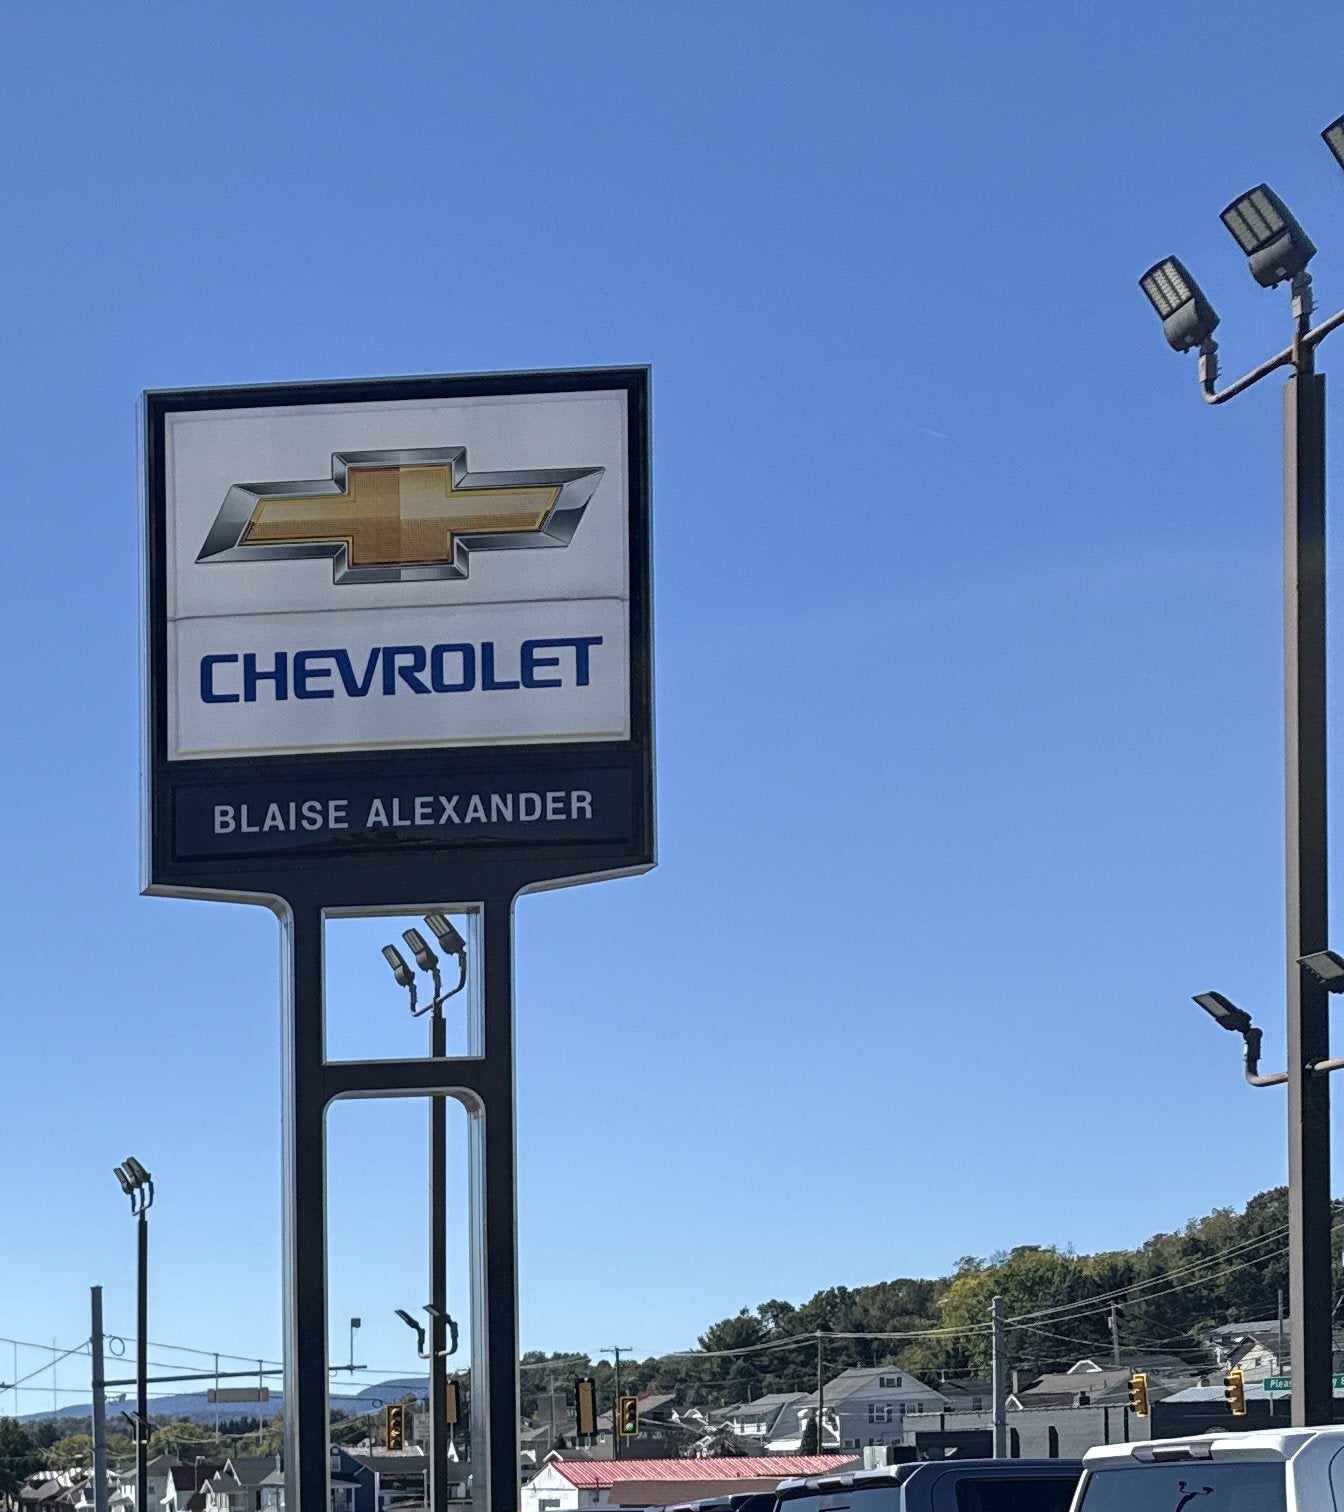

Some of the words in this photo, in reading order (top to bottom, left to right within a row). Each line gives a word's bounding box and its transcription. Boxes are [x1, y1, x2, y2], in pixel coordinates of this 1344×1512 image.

[200, 636, 603, 704] CHEVROLET
[213, 799, 349, 835] BLAISE
[366, 790, 594, 829] ALEXANDER
